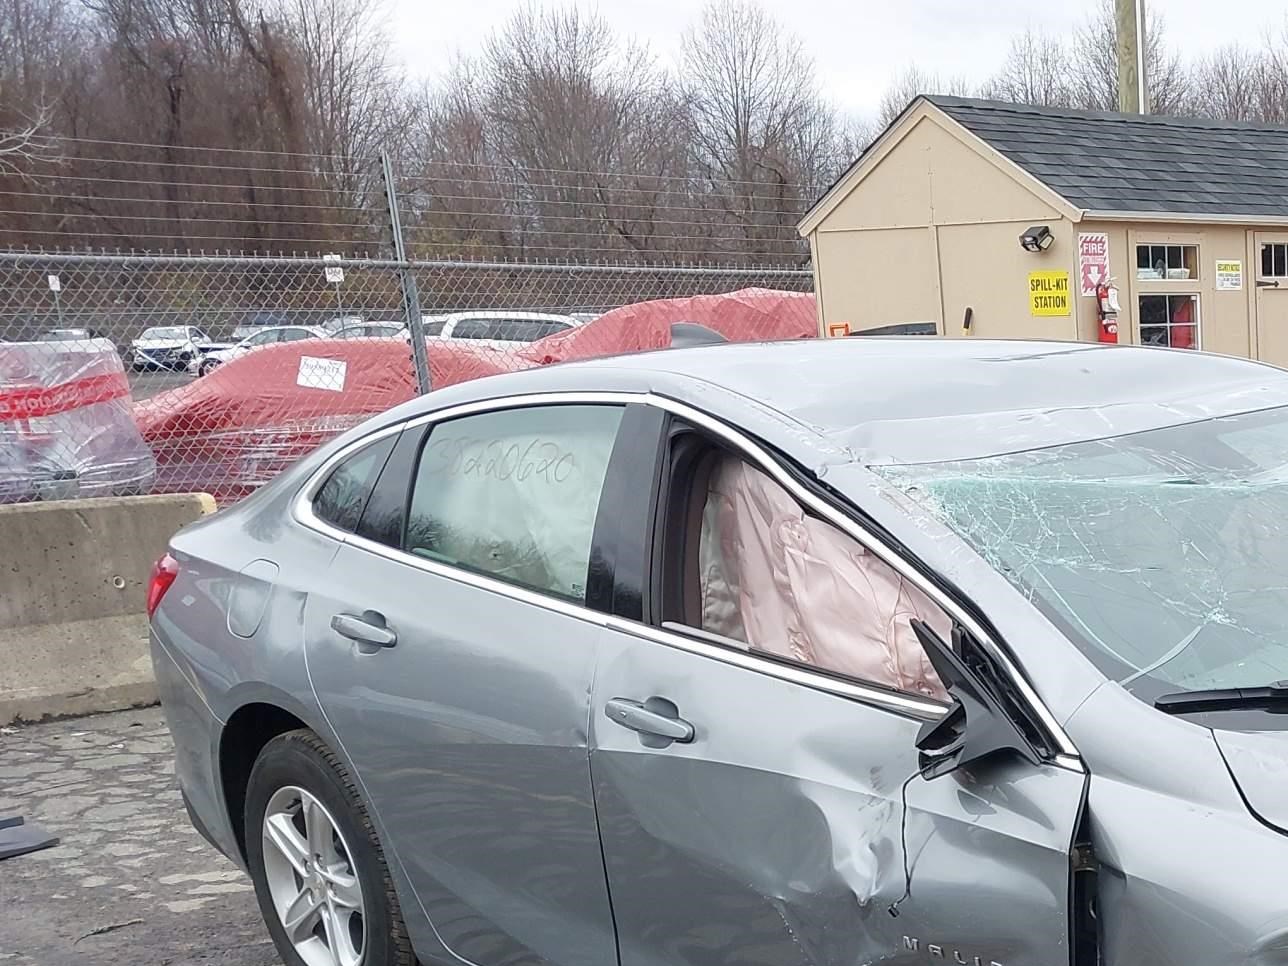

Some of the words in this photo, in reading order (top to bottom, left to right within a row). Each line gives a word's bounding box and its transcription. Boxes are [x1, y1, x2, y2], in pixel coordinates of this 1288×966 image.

[1083, 242, 1104, 254] FIRE
[1030, 278, 1068, 291] SPILL-KIT
[1034, 295, 1066, 308] STATION
